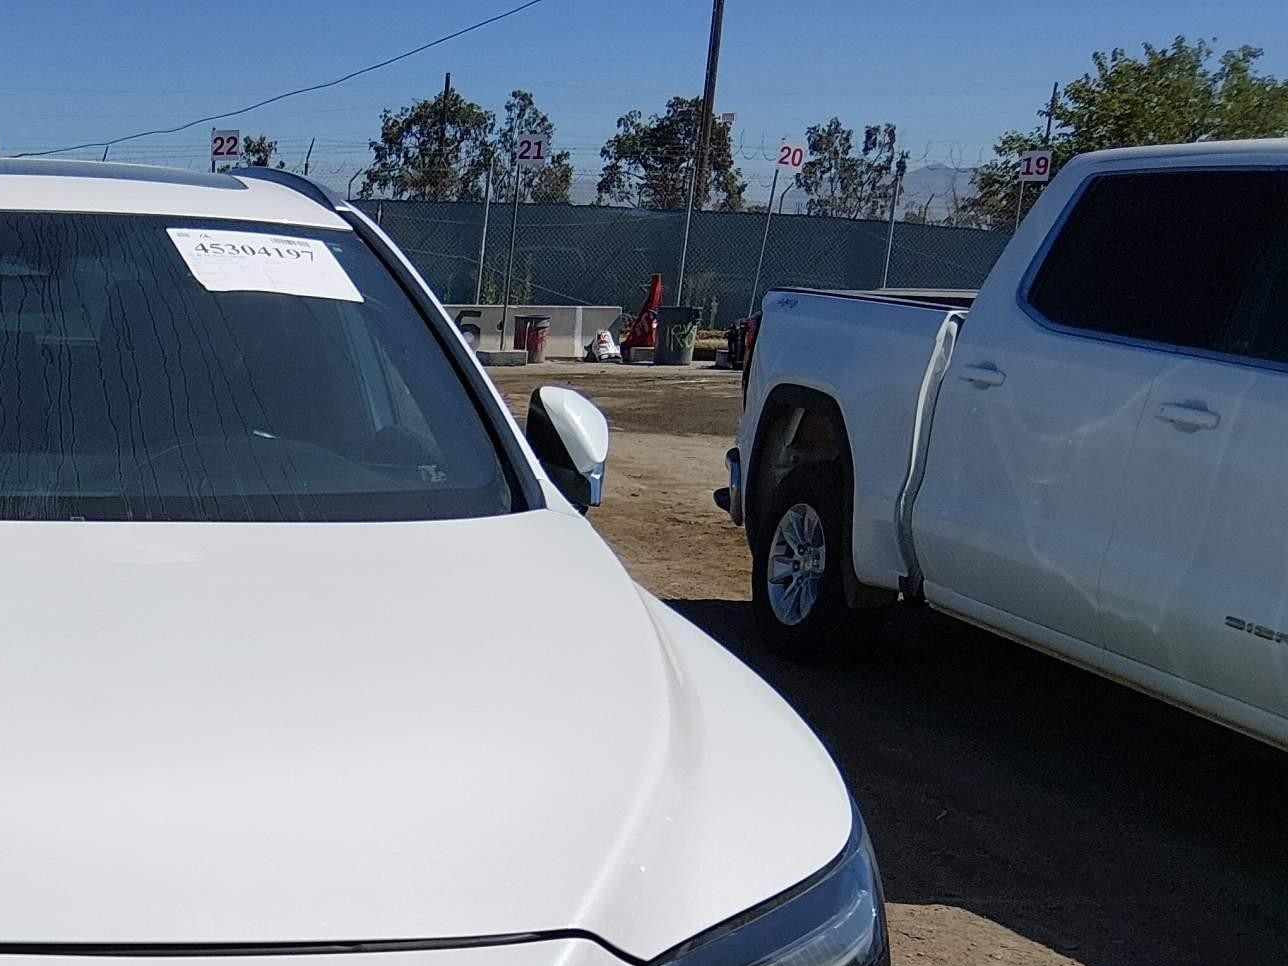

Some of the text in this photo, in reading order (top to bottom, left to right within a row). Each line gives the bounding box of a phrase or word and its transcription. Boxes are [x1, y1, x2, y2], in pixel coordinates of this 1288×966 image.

[213, 136, 238, 156] 22
[518, 139, 545, 160] 21
[777, 145, 804, 167] 20
[1021, 156, 1049, 176] 19
[194, 241, 315, 262] 45304197
